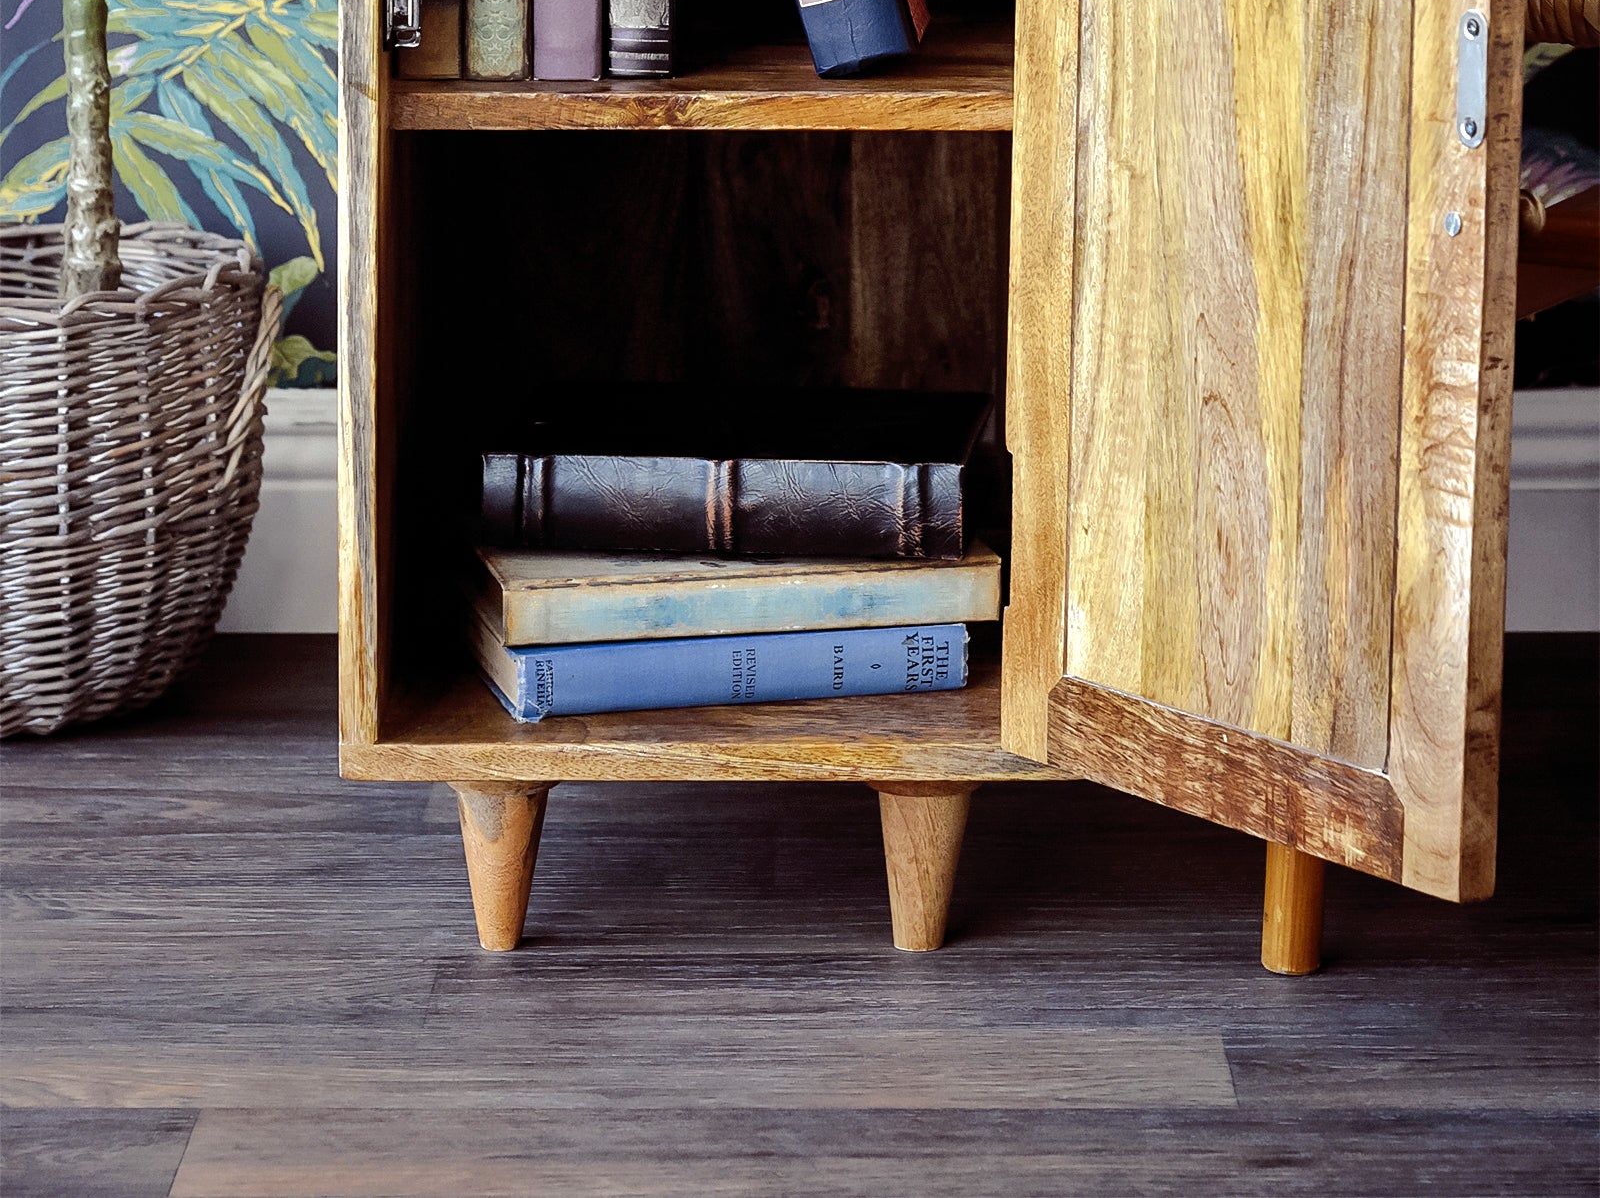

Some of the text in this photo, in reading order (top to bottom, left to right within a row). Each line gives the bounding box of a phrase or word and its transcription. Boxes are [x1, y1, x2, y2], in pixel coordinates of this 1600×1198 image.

[732, 650, 742, 700] EDITION
[744, 648, 756, 700] REVISED
[832, 644, 844, 691] BAIRD
[905, 631, 919, 692] YEARS
[921, 635, 934, 688] FIRST
[935, 640, 950, 681] THE
[535, 659, 545, 715] RINEHA
